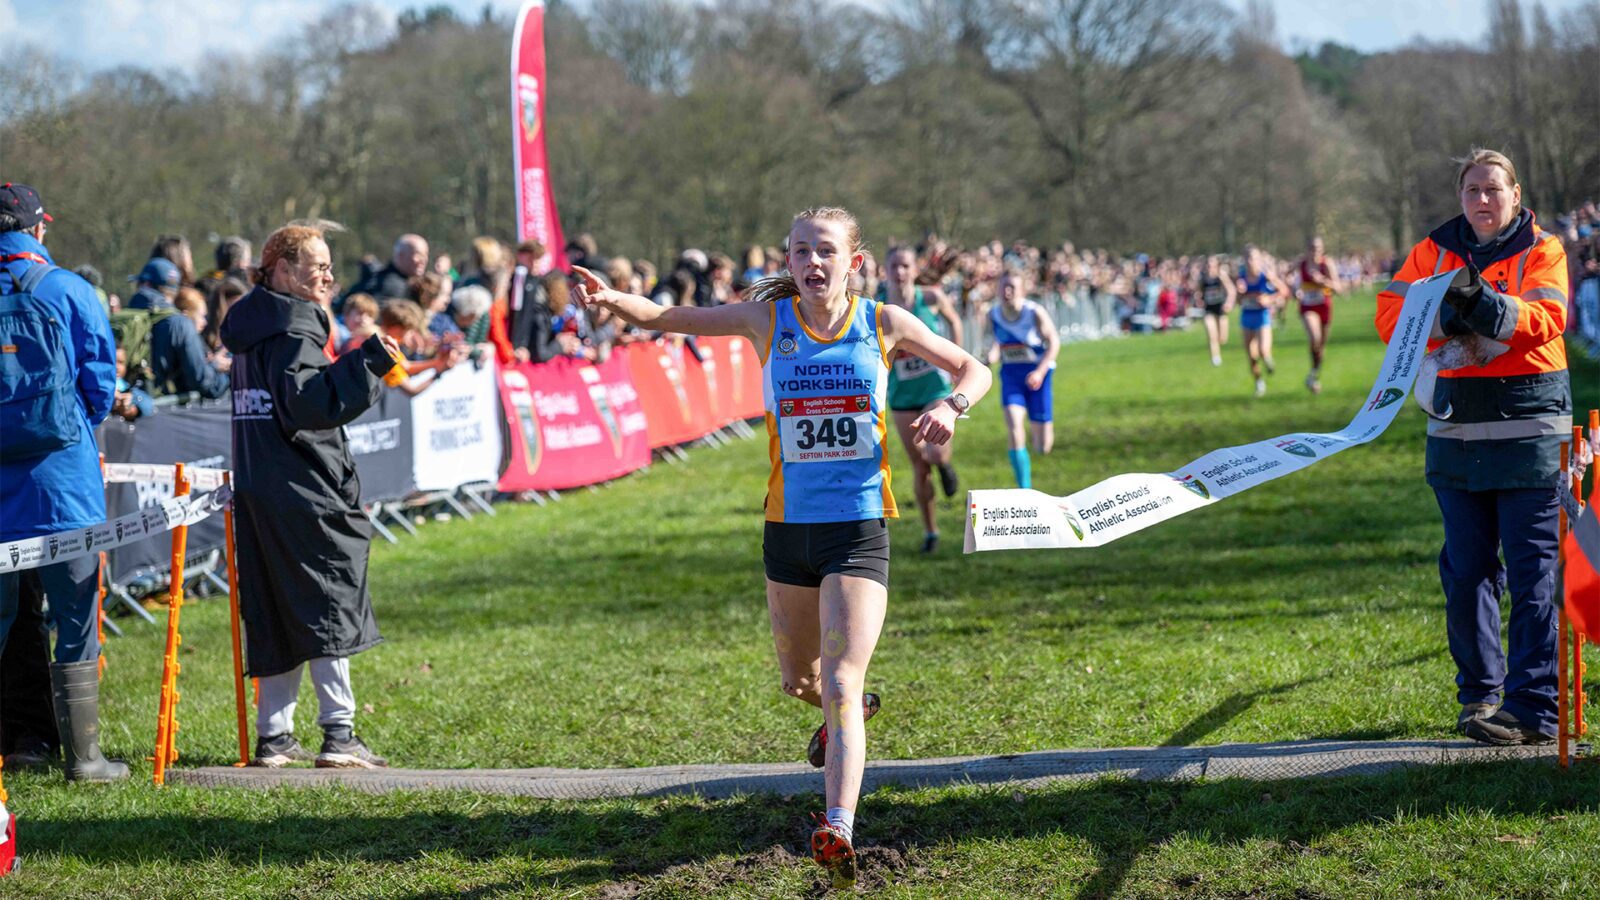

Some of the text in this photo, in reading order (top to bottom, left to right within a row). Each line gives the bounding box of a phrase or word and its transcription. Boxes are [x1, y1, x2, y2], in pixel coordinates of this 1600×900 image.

[1400, 298, 1433, 378] Athletic Association
[794, 363, 855, 377] NORTH
[1387, 351, 1405, 383] English
[777, 378, 872, 392] YORKSHIRE
[803, 398, 846, 408] English Schools
[805, 406, 844, 415] Cross Country
[796, 416, 857, 450] 349
[799, 449, 857, 460] SEFTON PARK 2026
[1201, 460, 1230, 479] English
[1215, 471, 1246, 487] Athletic
[983, 507, 1009, 522] English
[1078, 497, 1116, 521] English
[982, 523, 1051, 537] Athletic Association
[1088, 512, 1125, 535] Athletic
